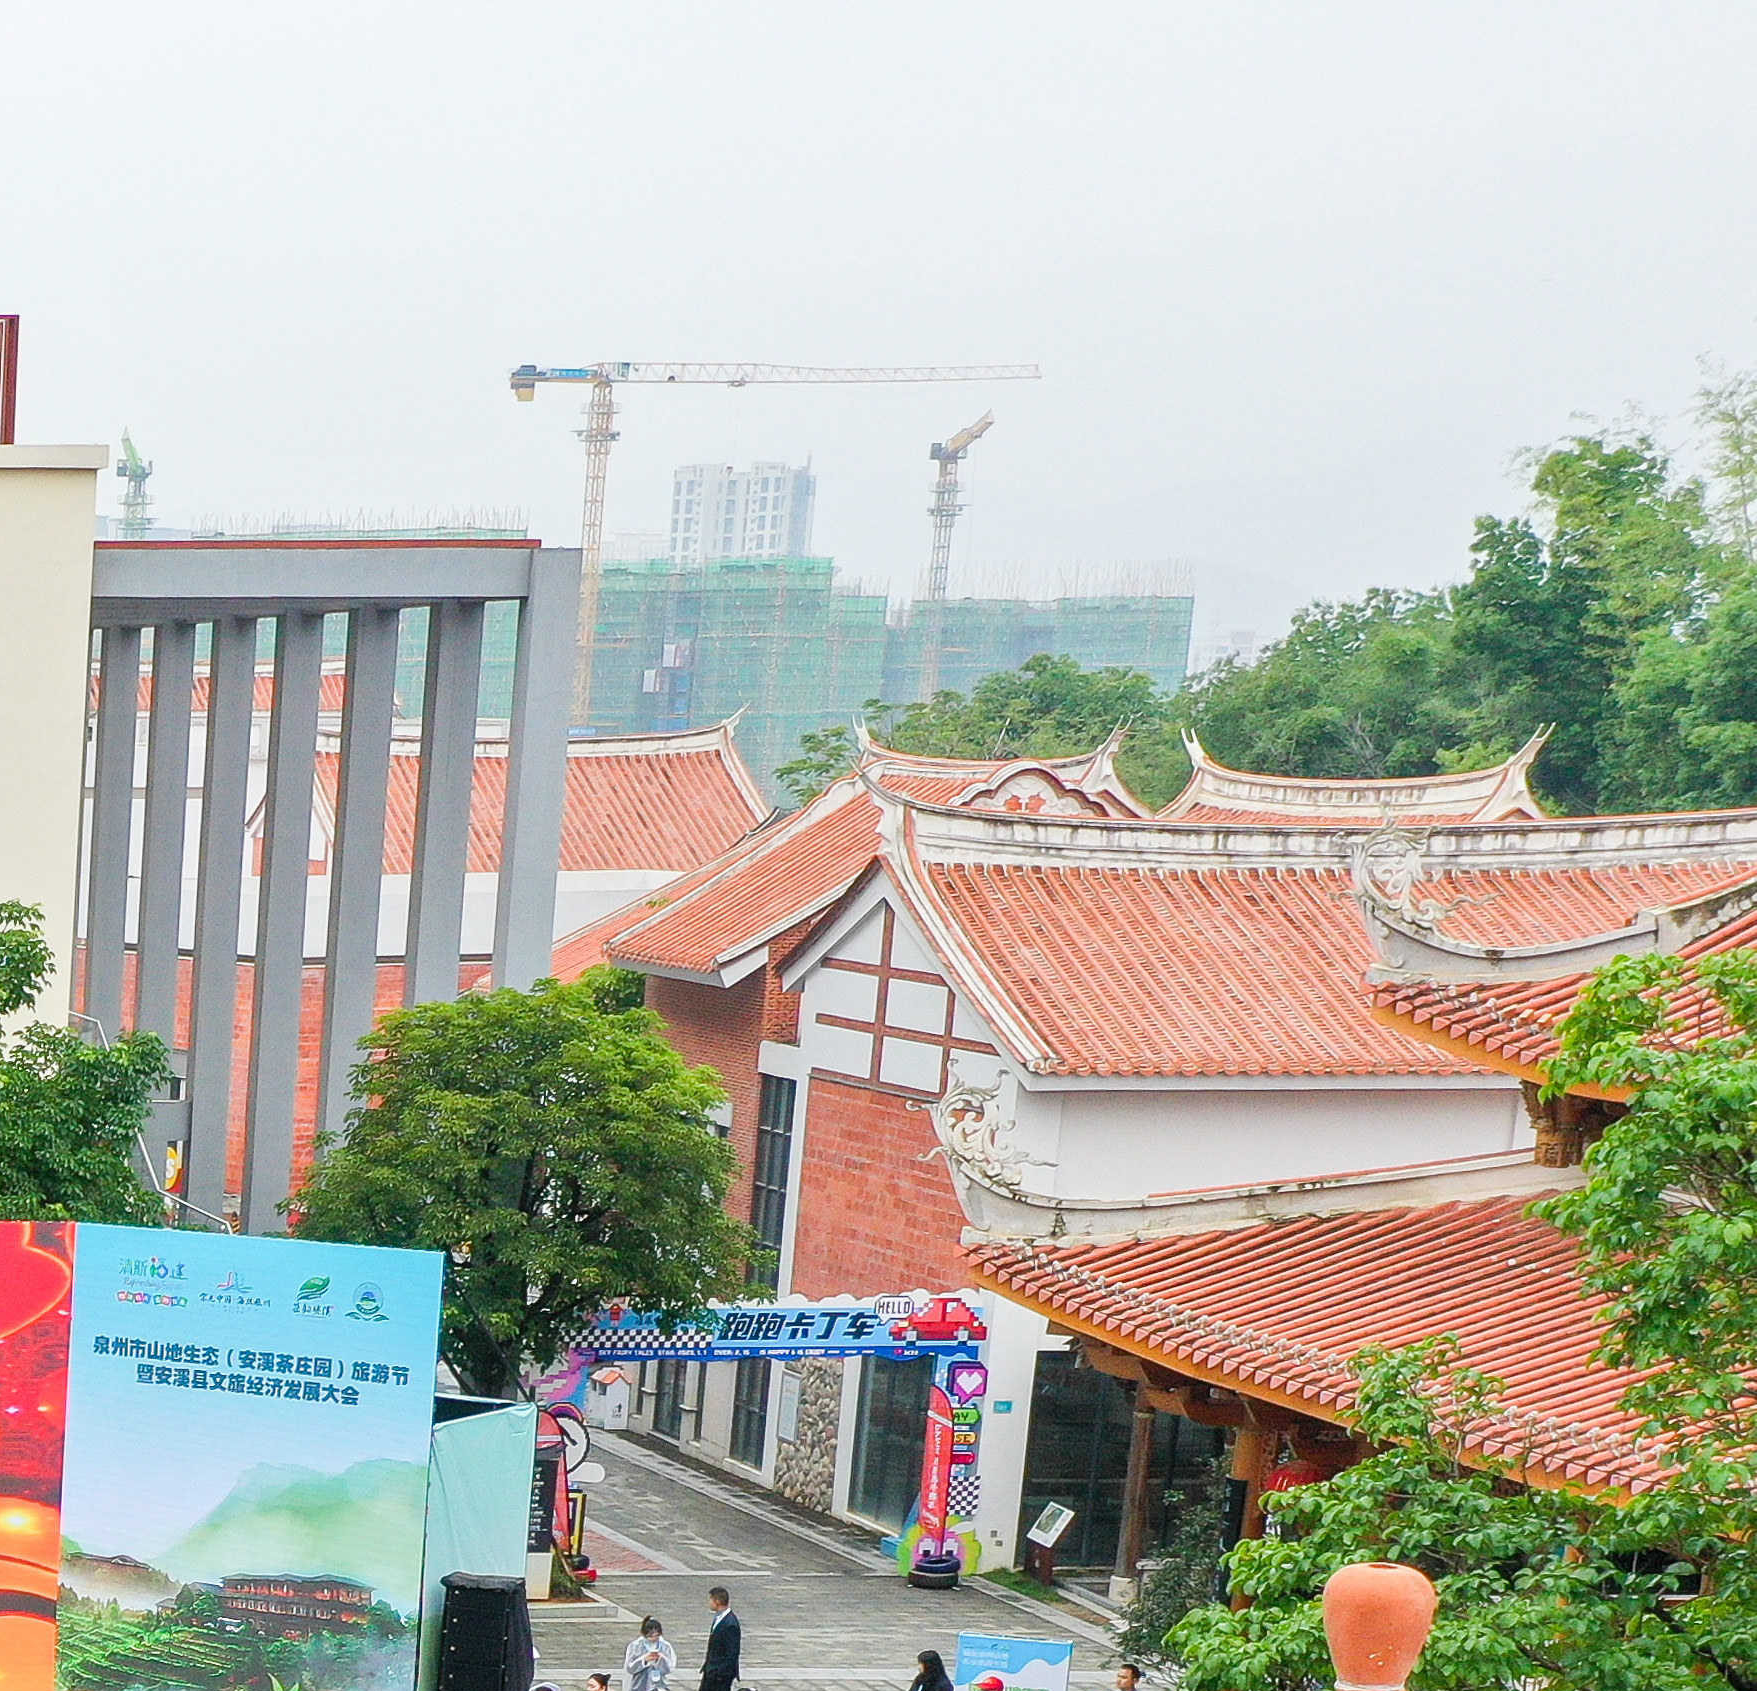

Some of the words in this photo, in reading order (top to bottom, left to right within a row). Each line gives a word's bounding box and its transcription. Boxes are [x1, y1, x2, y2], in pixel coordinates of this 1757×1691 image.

[877, 1301, 911, 1315] HELLO
[716, 1311, 879, 1341] 跑跑卡丁车
[93, 1335, 410, 1386] 泉州市山地生态（安溪茶庄园）旅游节
[136, 1363, 360, 1406] 暨安溪县文旅经济发展大会
[953, 1412, 969, 1422] AY
[955, 1433, 970, 1443] SE
